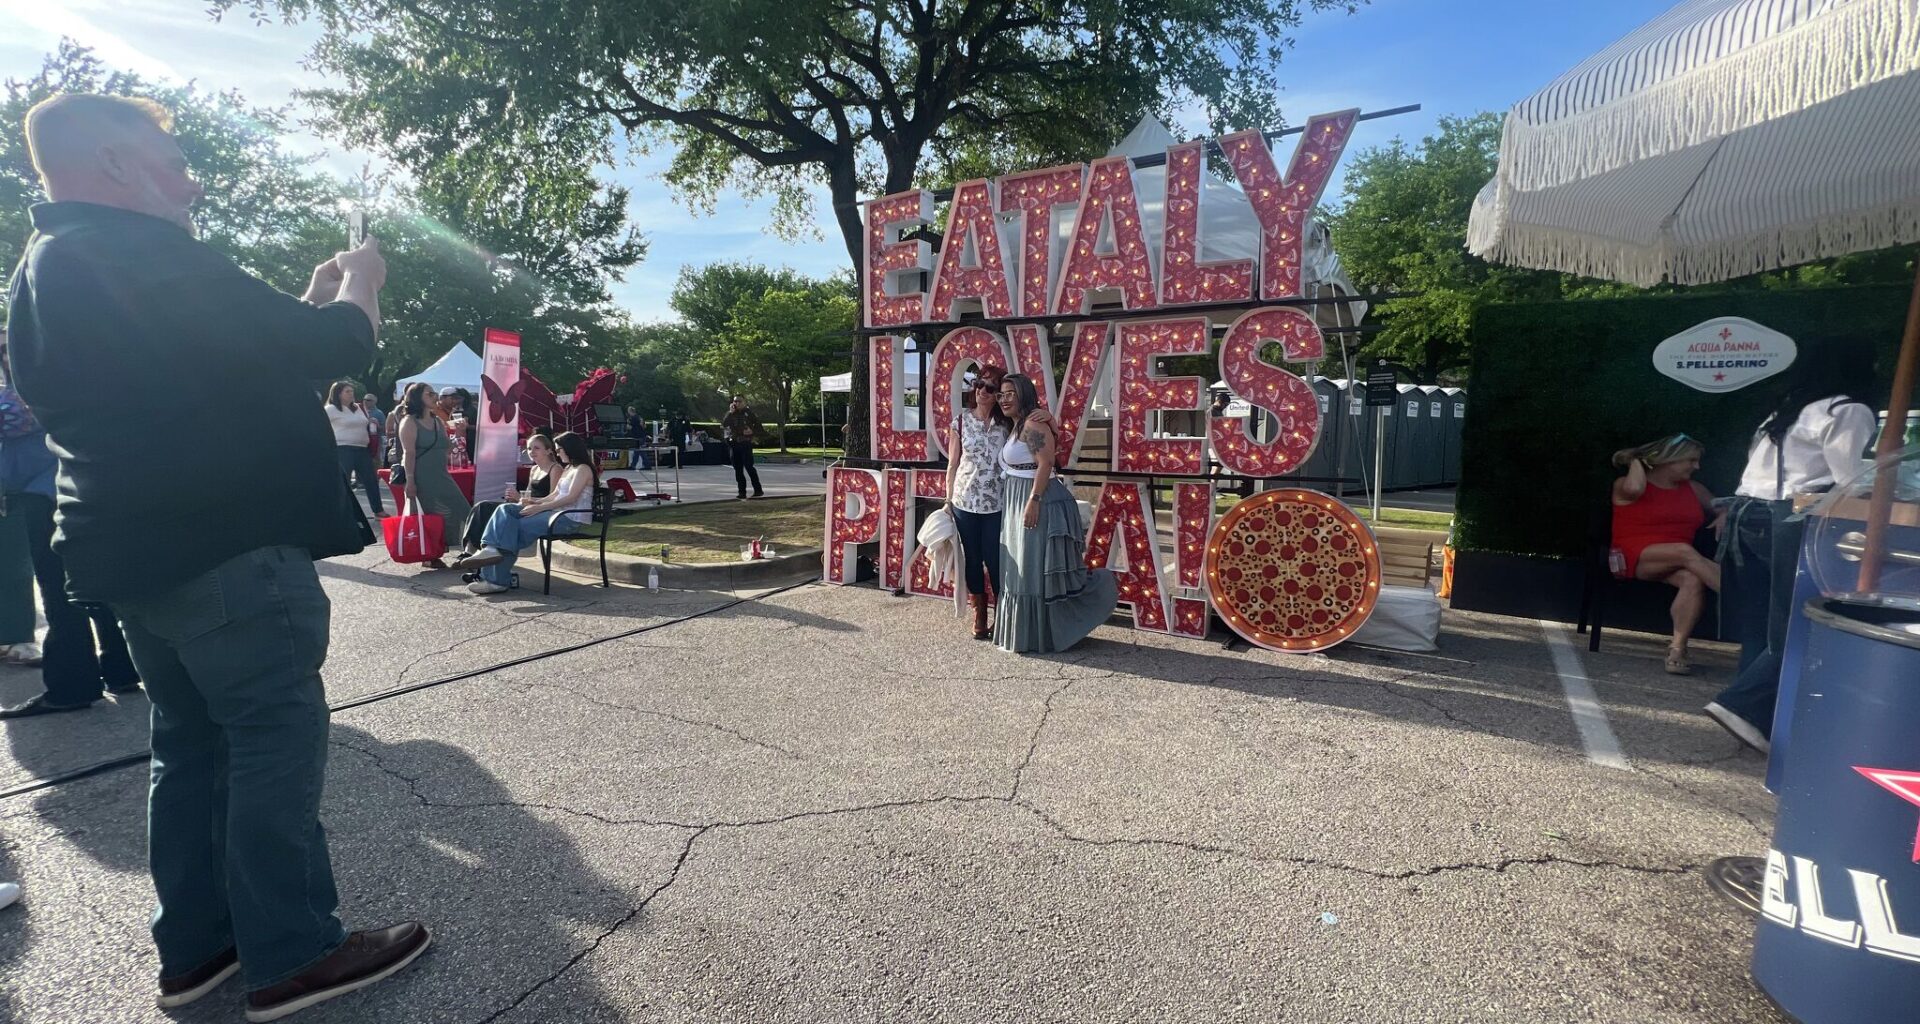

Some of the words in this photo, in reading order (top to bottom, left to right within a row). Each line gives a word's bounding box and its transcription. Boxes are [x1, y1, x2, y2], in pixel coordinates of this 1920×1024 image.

[864, 108, 1360, 328] EATALY
[868, 306, 1325, 477] LOVES
[1676, 359, 1769, 369] S.PELLEGRINO
[1687, 343, 1721, 353] ACQUA
[1723, 342, 1761, 352] PANNA
[824, 466, 1216, 640] PIA!
